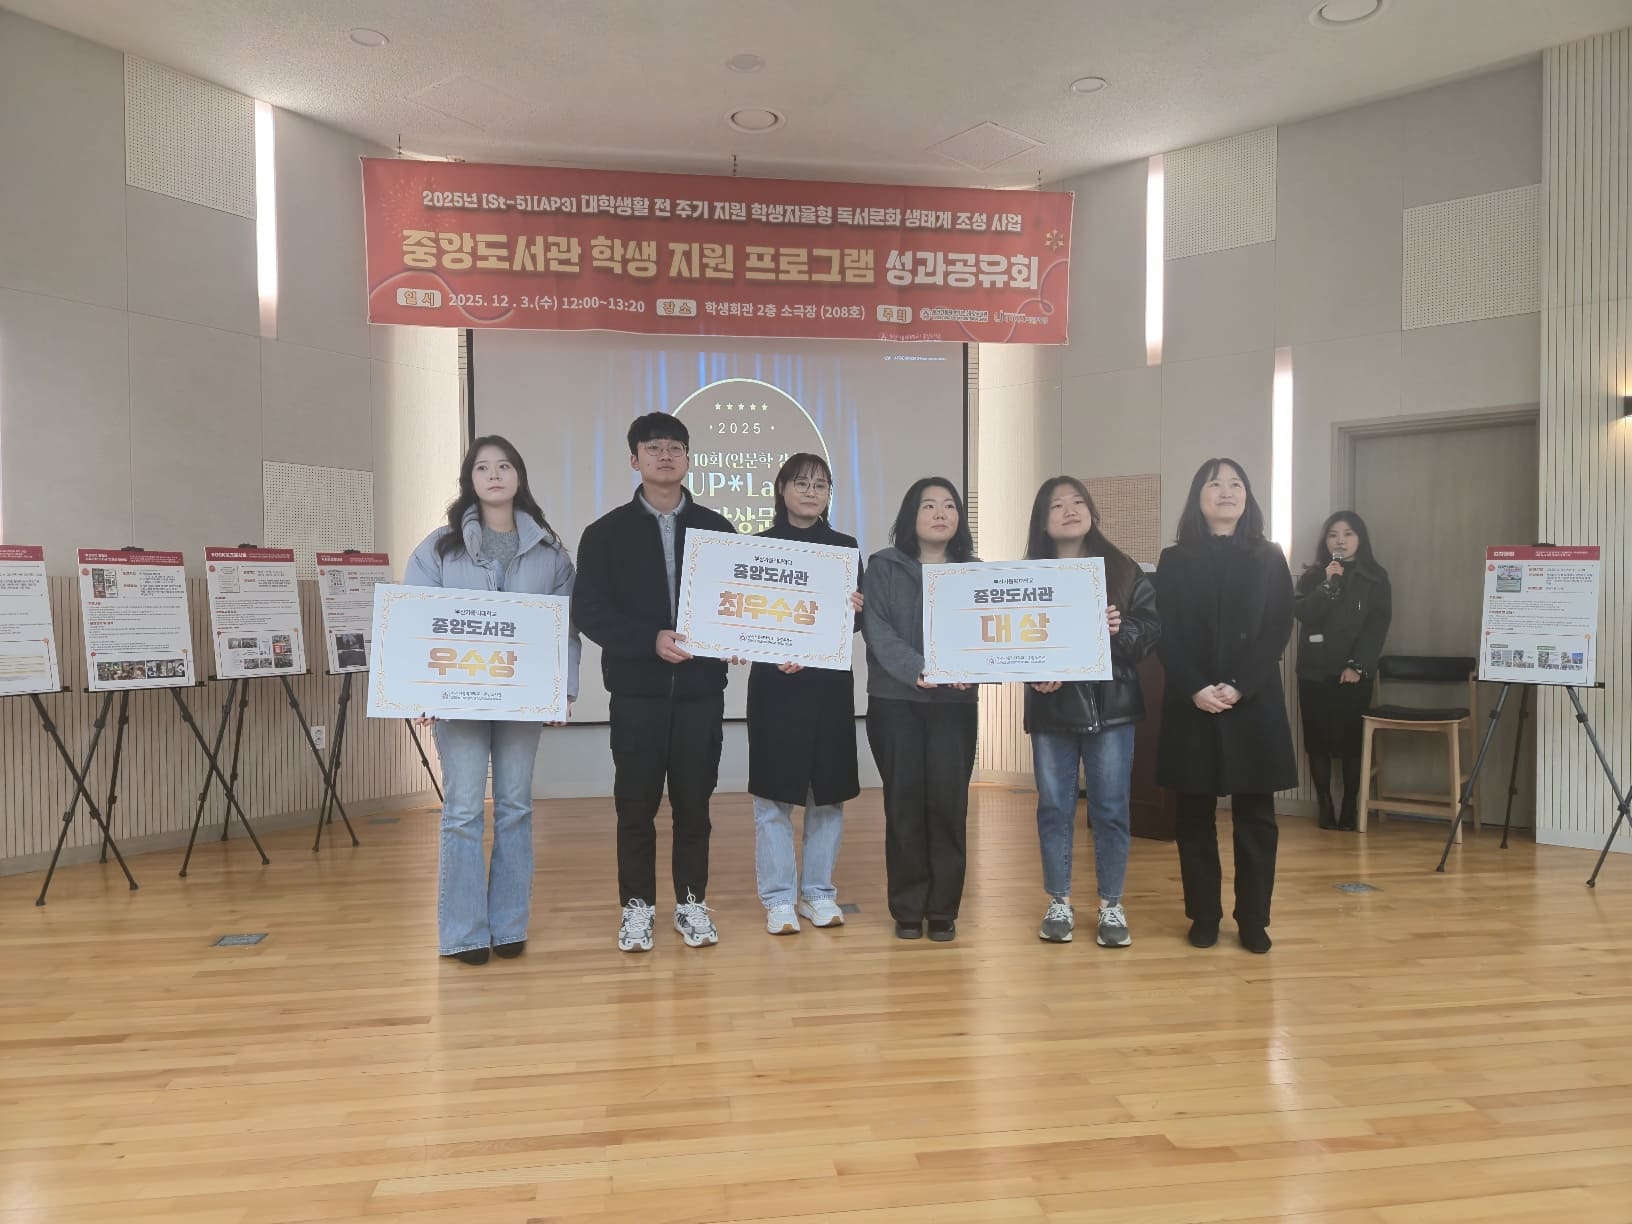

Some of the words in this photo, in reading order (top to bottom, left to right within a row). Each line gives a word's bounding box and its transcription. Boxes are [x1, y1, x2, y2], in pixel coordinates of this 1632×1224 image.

[422, 190, 478, 209] 2025년
[581, 194, 649, 217] 대학생활
[655, 197, 671, 217] 전
[676, 199, 709, 219] 주기
[714, 201, 746, 221] 지원
[751, 202, 832, 225] 학생자율형
[837, 206, 901, 227] 독서문화
[905, 209, 951, 229] 생태계
[955, 211, 987, 231] 조성
[991, 213, 1022, 232] 사업
[402, 229, 581, 273] 중앙도서관
[590, 235, 657, 278] 학생
[668, 242, 733, 279] 지원
[744, 245, 875, 284] 프로그램
[885, 249, 1039, 290] 성과공유회
[562, 295, 645, 313] 12:00~13:20
[704, 302, 753, 316] 학생회관
[757, 303, 777, 317] 2층
[781, 304, 818, 318] 소극장
[821, 304, 866, 320] (208호)
[718, 422, 761, 434] 2025
[733, 563, 809, 586] 중앙도서관
[973, 586, 1055, 604] 중앙도서관
[717, 590, 819, 626] 최우수상
[431, 617, 517, 638] 중앙도서관
[427, 647, 518, 679] 우수상
